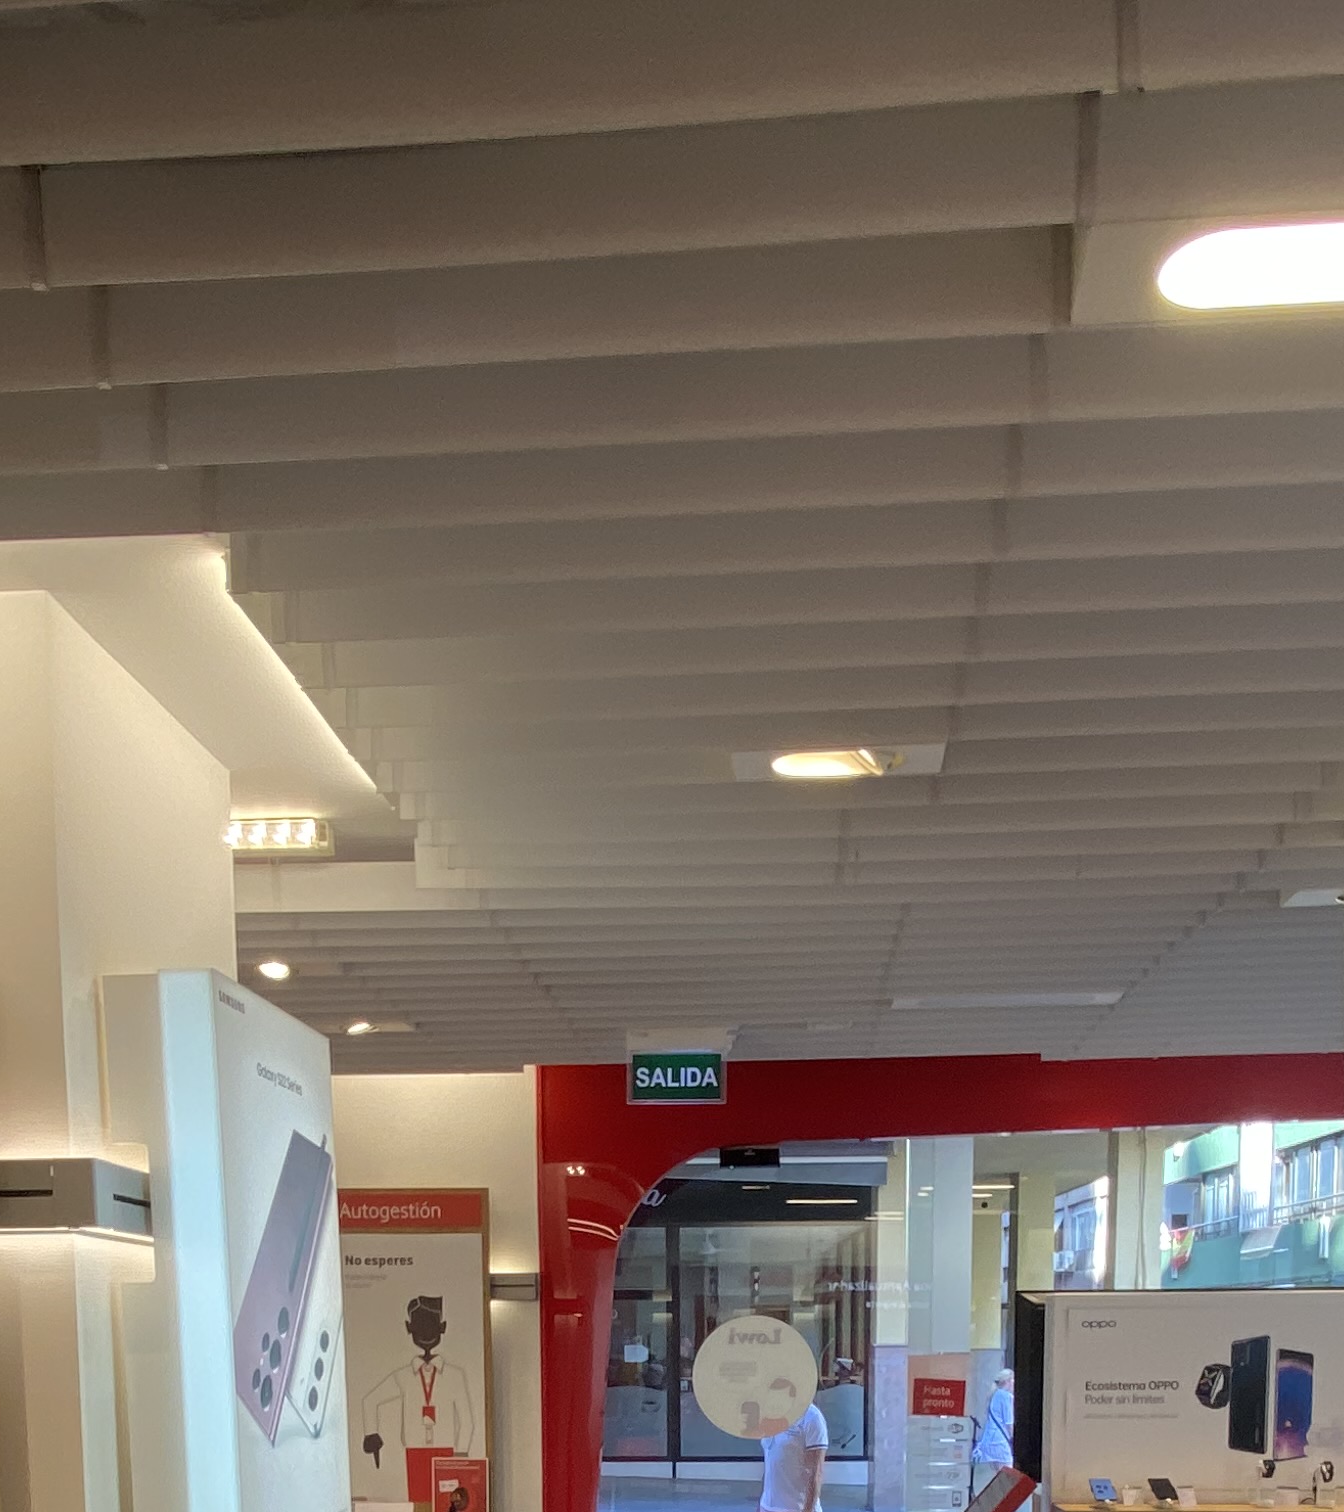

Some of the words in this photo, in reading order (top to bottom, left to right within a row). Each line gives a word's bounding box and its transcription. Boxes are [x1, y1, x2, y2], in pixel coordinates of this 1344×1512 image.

[636, 1066, 719, 1088] SALIDA
[339, 1200, 442, 1223] Autogestión
[344, 1255, 362, 1266] No
[364, 1256, 414, 1268] esperes
[1085, 1381, 1146, 1391] Ecosistema
[1148, 1380, 1179, 1391] OPPO
